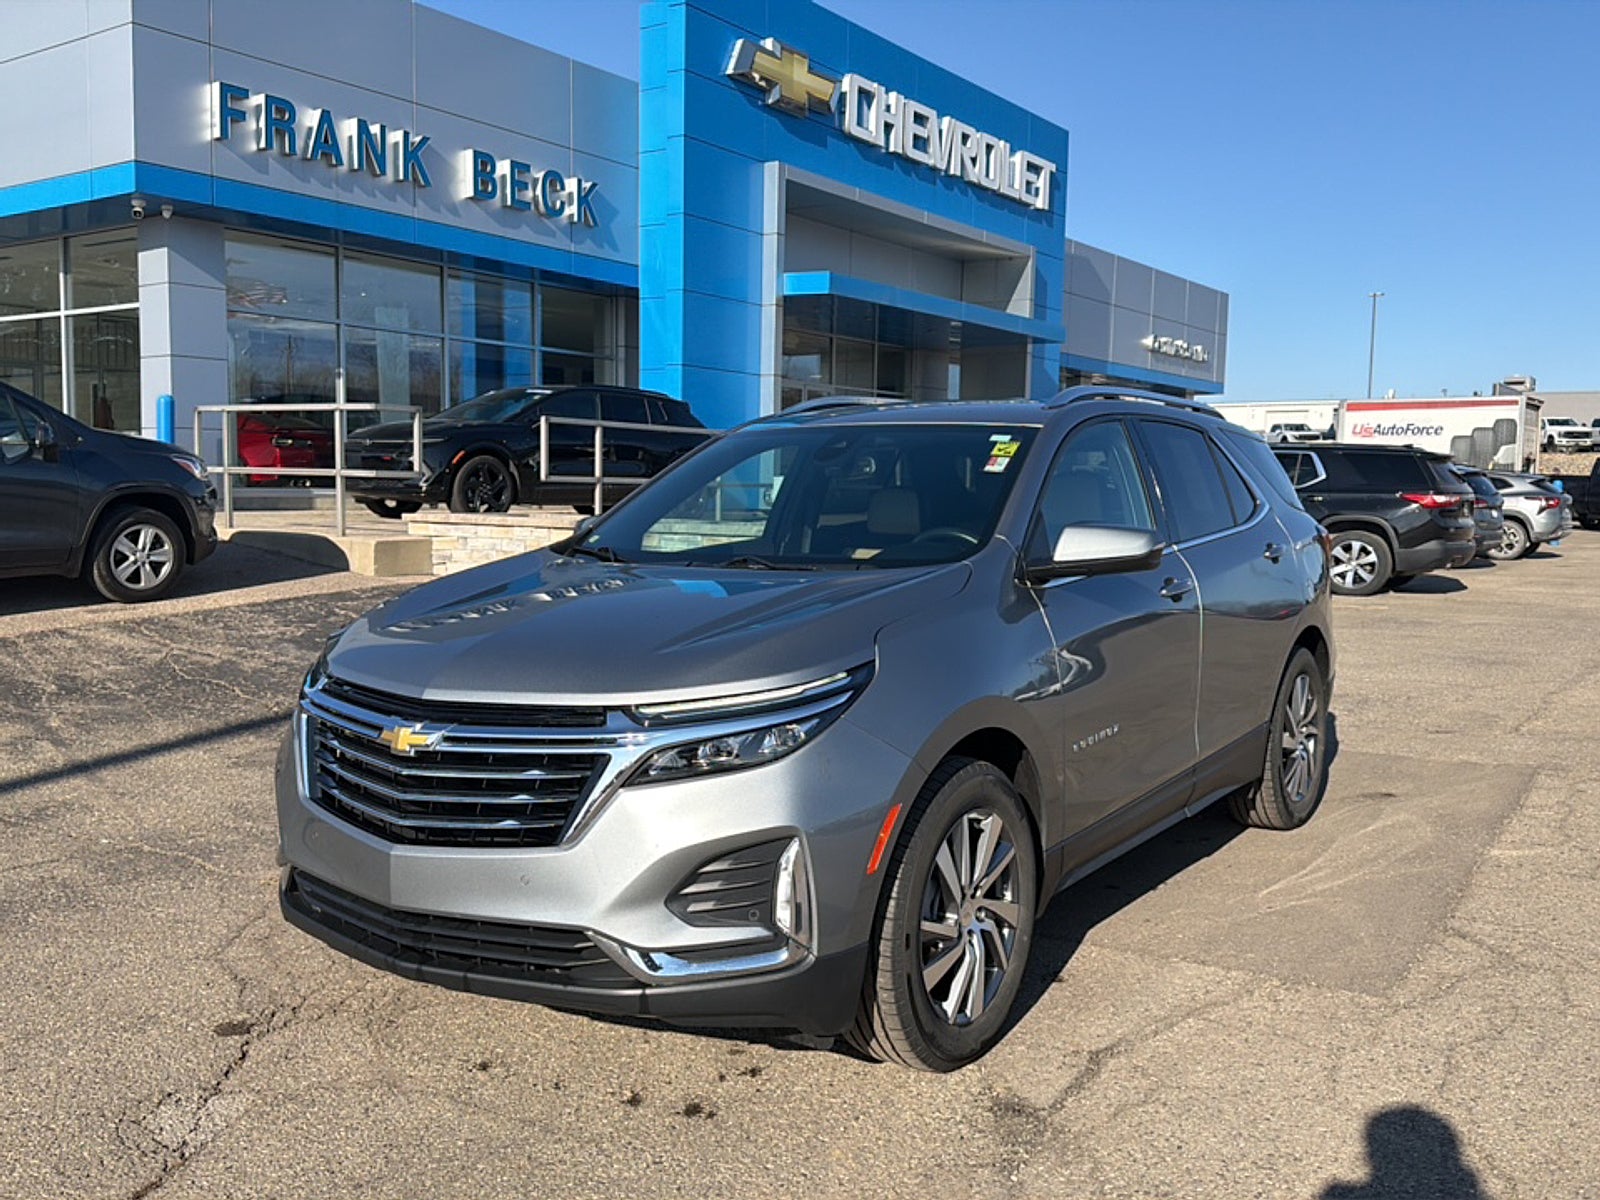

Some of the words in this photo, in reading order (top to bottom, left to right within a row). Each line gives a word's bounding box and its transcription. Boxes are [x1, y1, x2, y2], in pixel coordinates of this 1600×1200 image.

[213, 81, 432, 188] FRANK
[463, 149, 599, 228] BECK
[841, 73, 1056, 211] CHEVROLET
